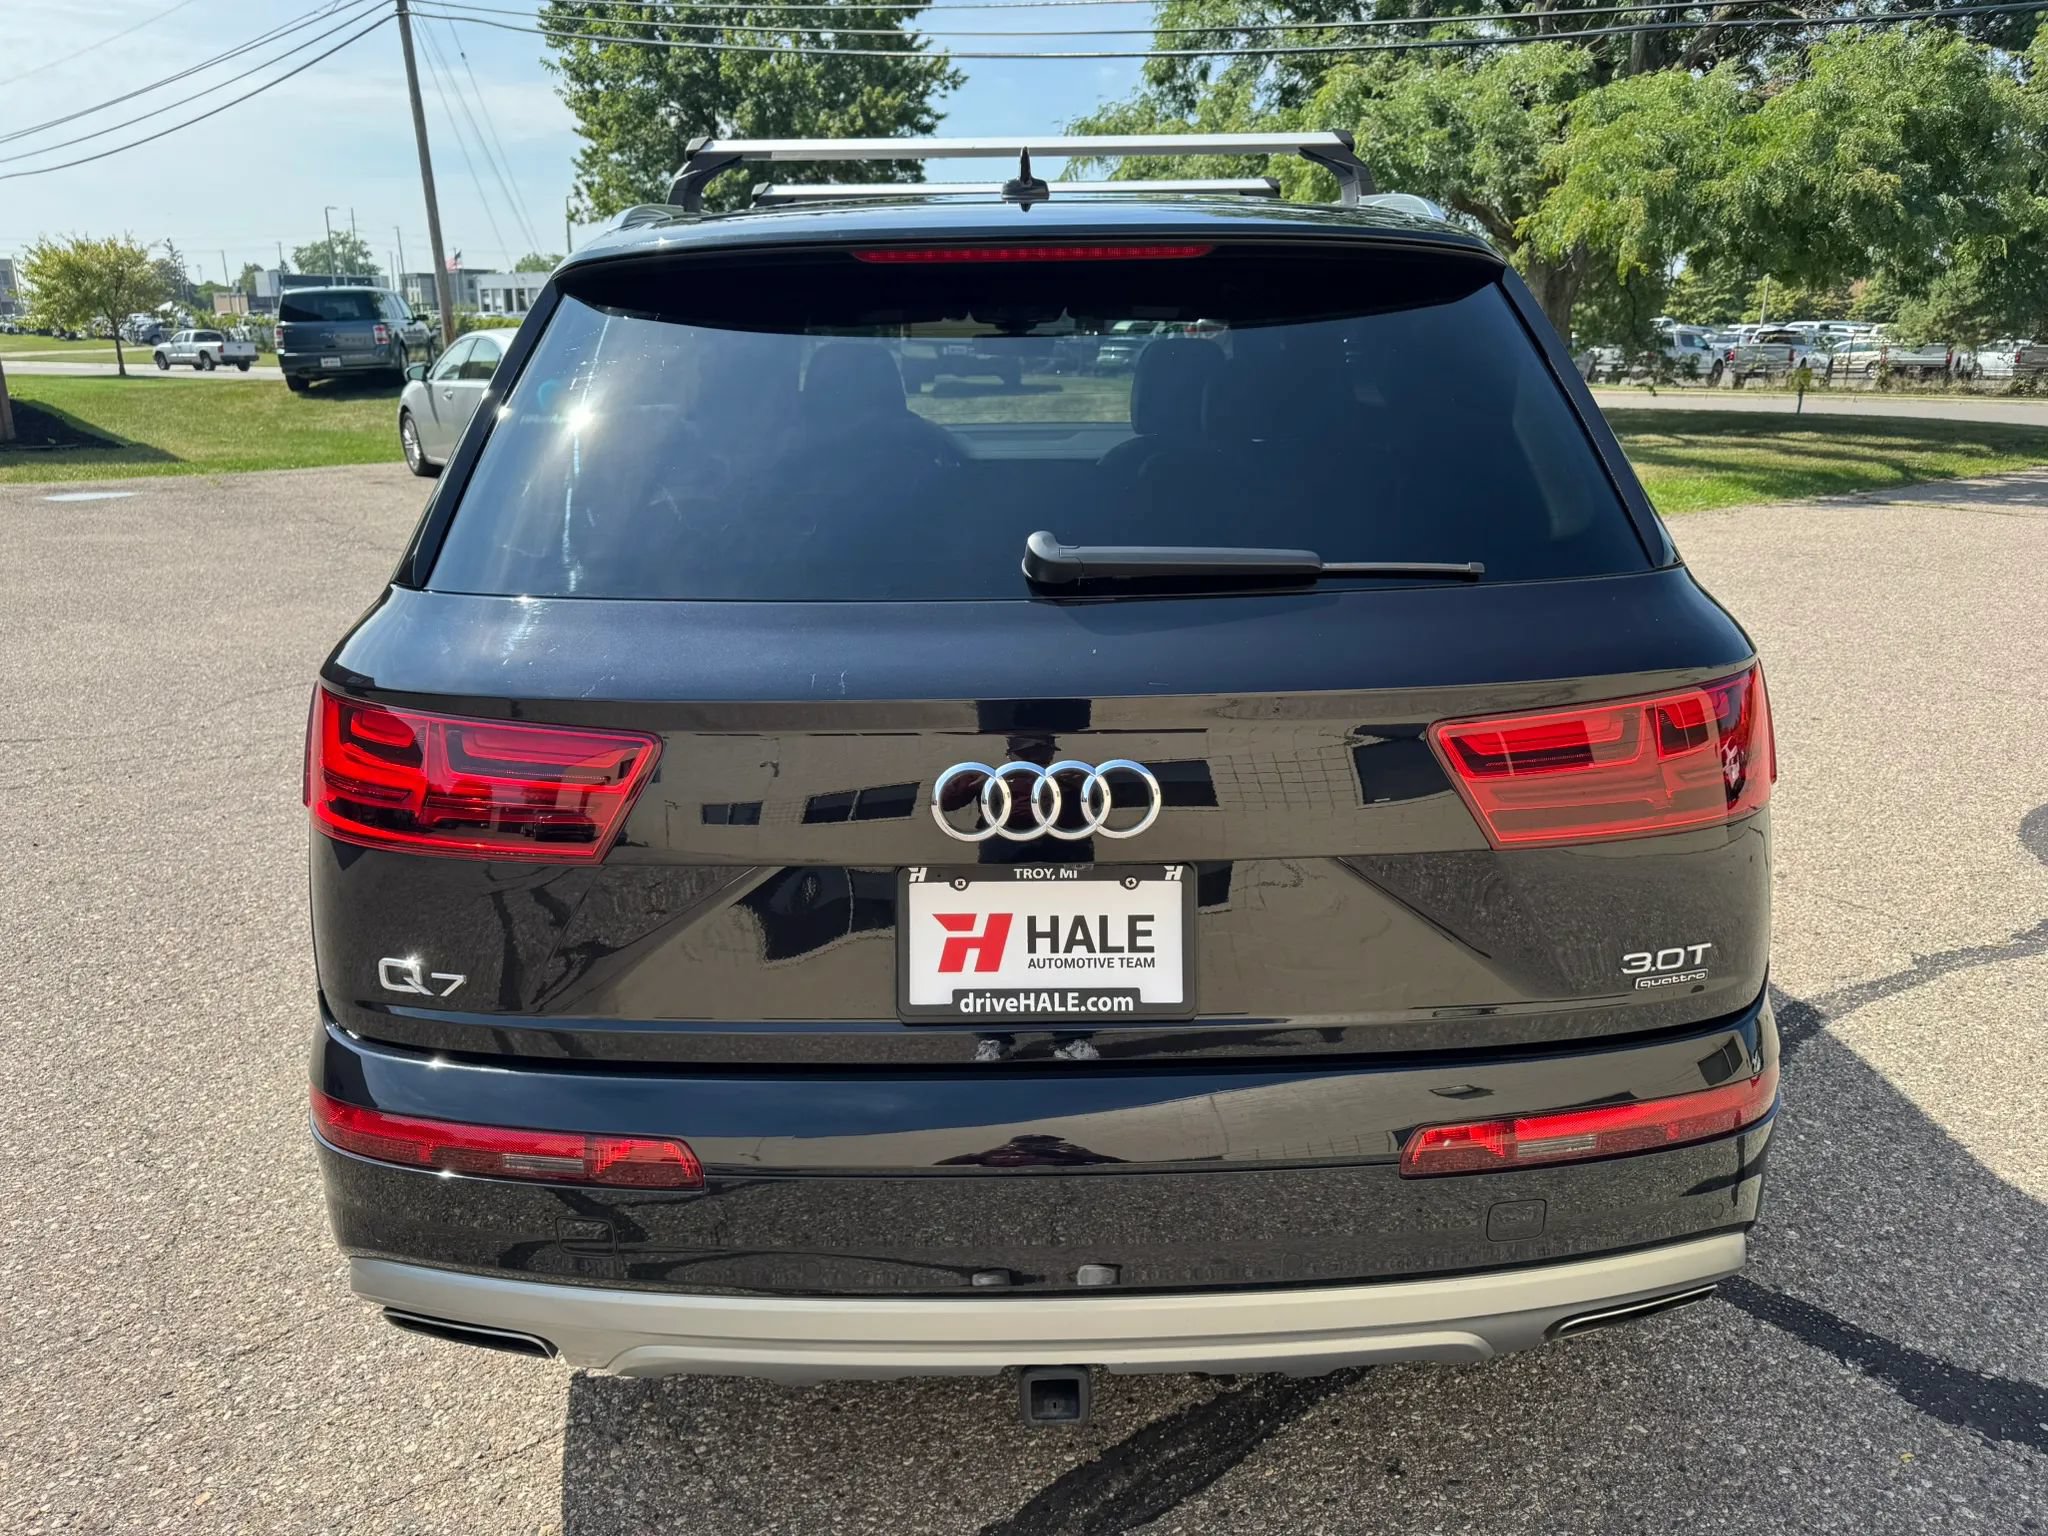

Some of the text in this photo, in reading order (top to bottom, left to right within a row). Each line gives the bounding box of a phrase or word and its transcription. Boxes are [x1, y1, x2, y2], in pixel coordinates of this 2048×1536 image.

[1014, 868, 1056, 880] TROY,
[1027, 914, 1155, 954] HALE
[1027, 957, 1155, 969] AUTOMOTIVE TEAM
[1621, 942, 1712, 974] 3.0T
[378, 957, 467, 997] Q7
[1640, 972, 1705, 988] quattro
[960, 992, 1133, 1013] driveHALE.com
